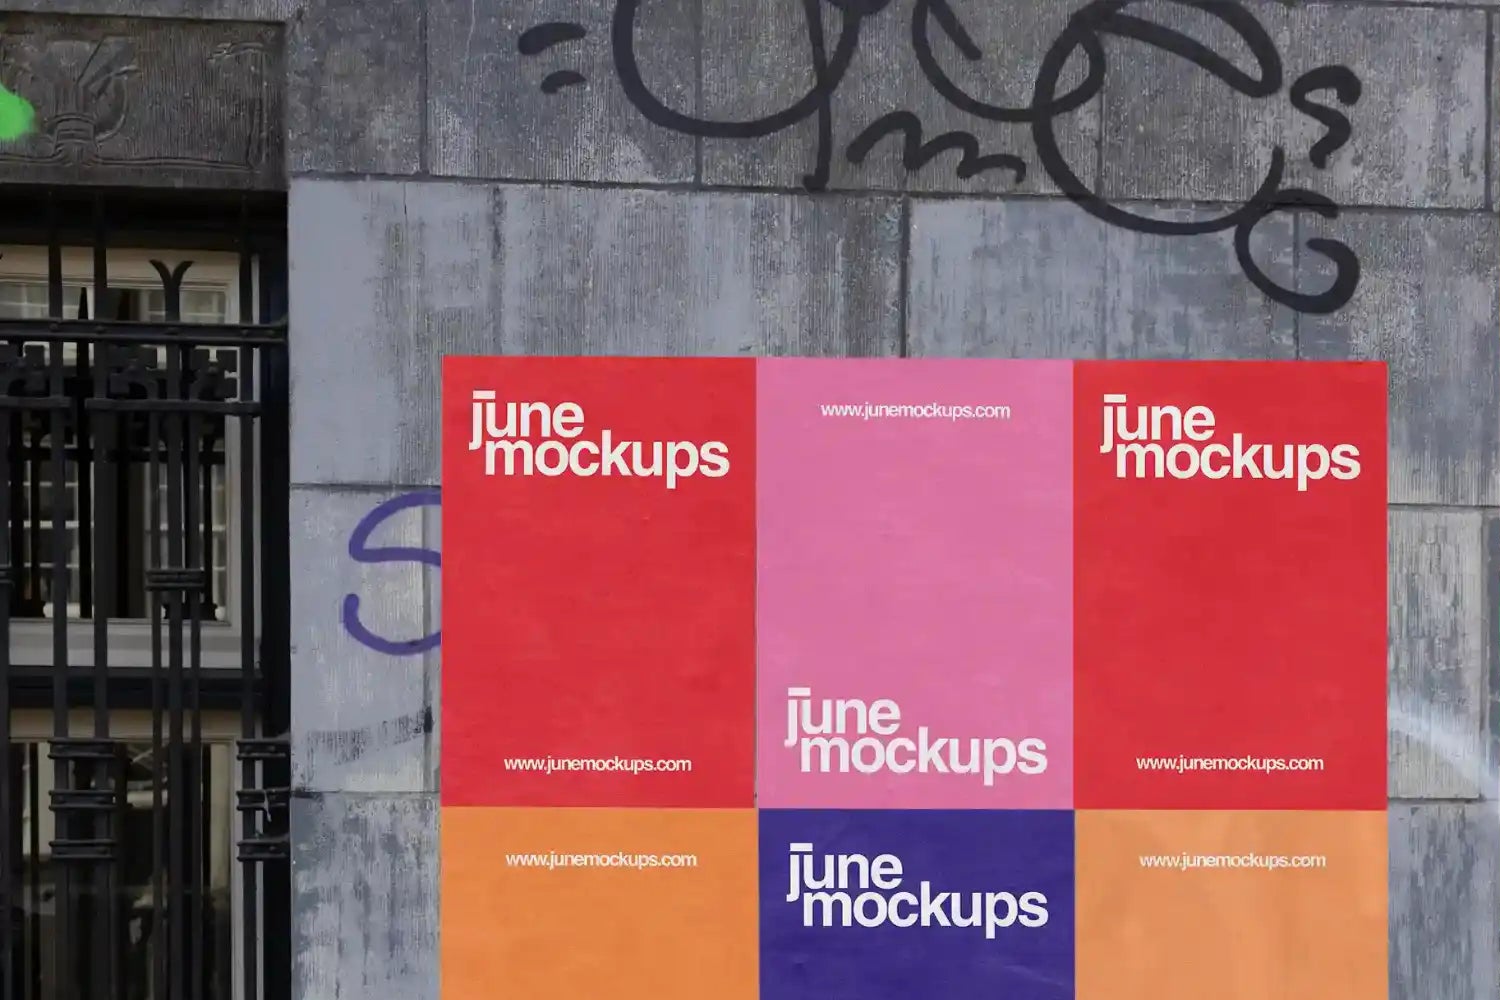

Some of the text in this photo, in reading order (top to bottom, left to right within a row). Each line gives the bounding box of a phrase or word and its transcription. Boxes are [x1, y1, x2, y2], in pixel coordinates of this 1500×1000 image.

[469, 391, 584, 450] june
[820, 404, 1010, 418] www.junemockups.com
[1100, 394, 1215, 453] june
[486, 430, 729, 488] mockups
[1117, 433, 1360, 491] mockups
[785, 688, 899, 748] june
[504, 756, 691, 770] www.junemockups.com
[802, 728, 1046, 784] mockups
[1137, 756, 1323, 770] www.junemockups.com
[506, 853, 697, 869] www.junemockups.com
[787, 843, 902, 902] june
[1139, 853, 1326, 870] www.junemockups.com
[804, 881, 1048, 938] mockups
